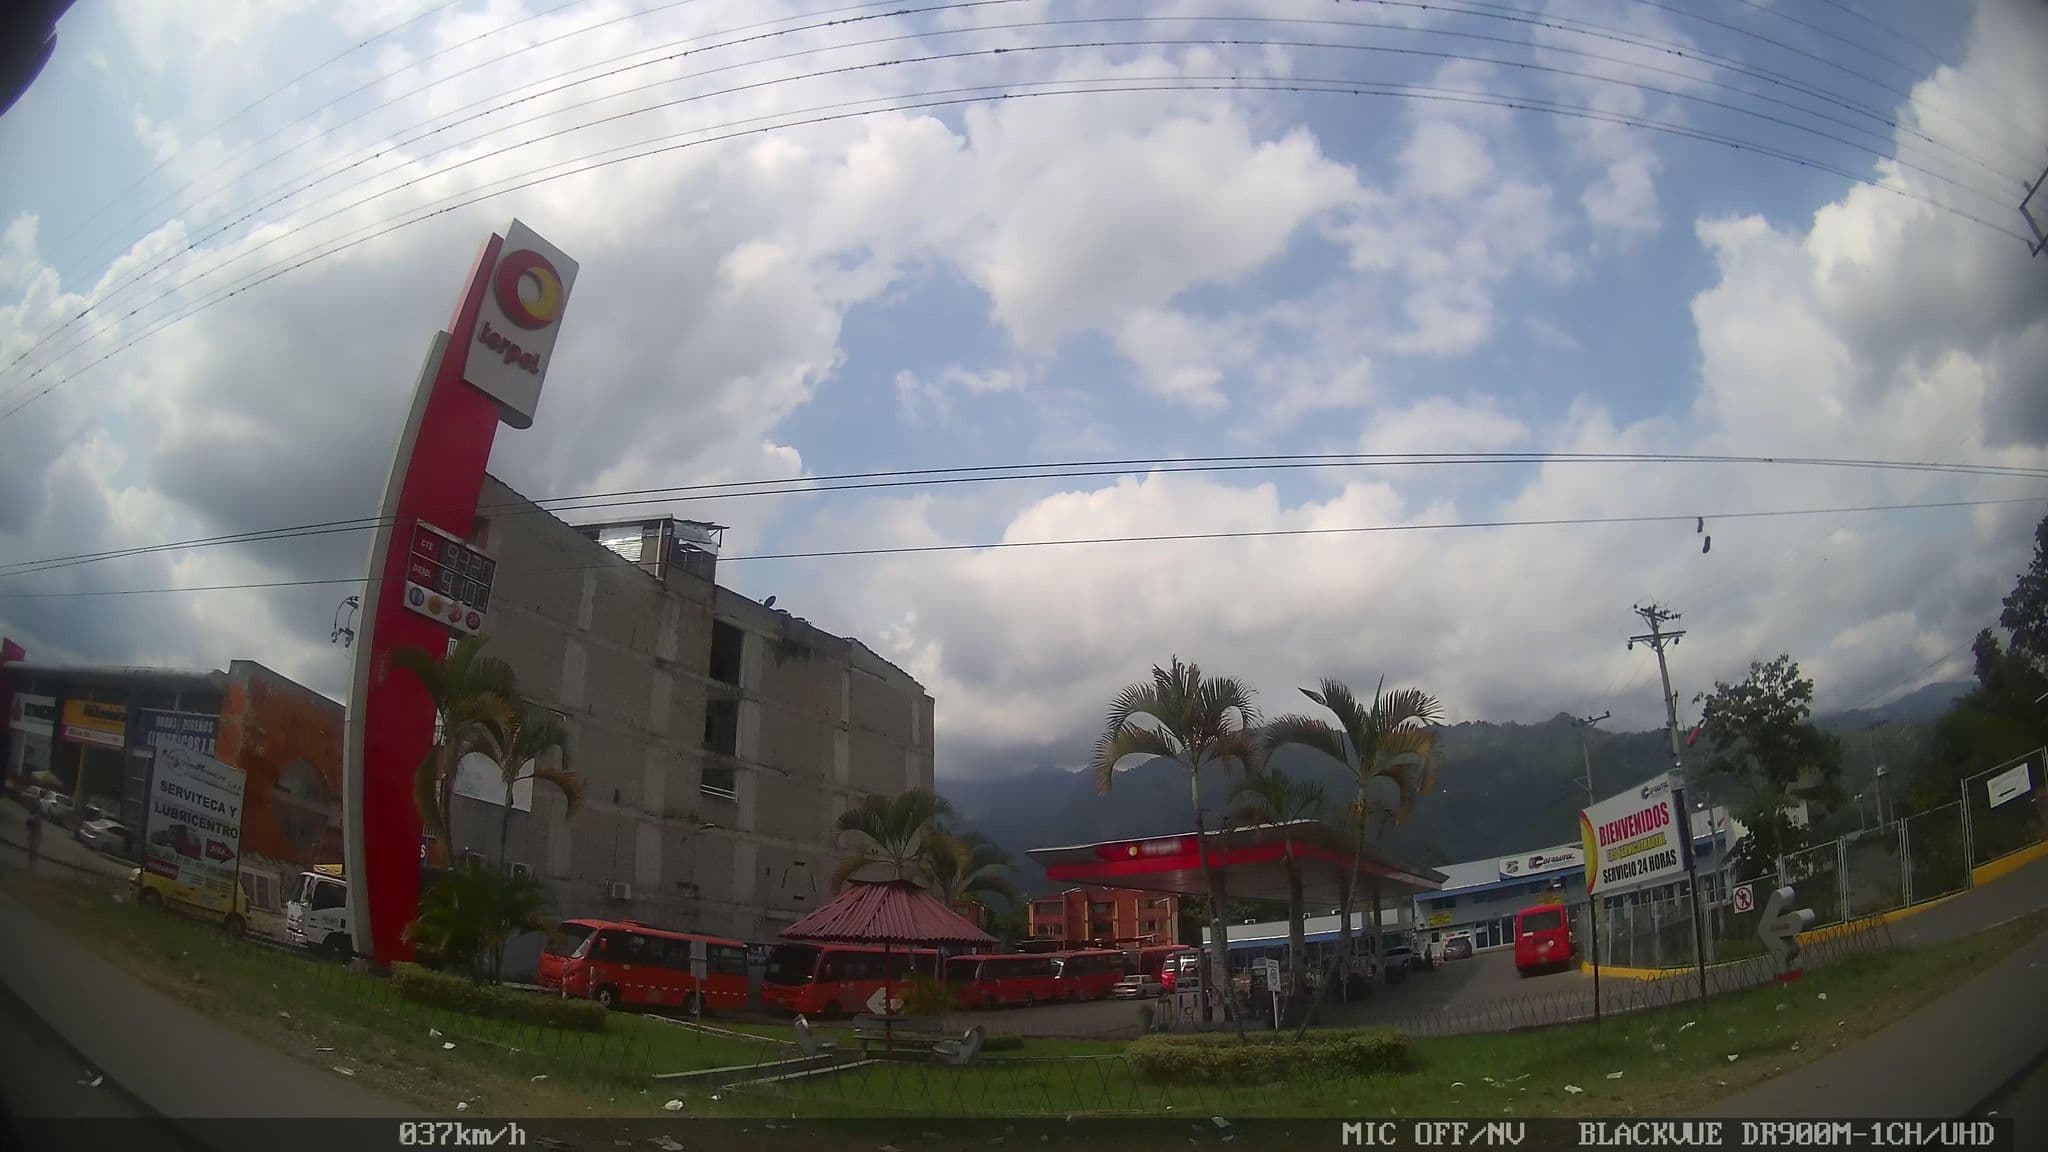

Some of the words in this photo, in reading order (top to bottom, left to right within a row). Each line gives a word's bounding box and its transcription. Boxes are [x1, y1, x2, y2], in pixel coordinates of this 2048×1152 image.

[478, 320, 541, 374] terpel
[160, 781, 225, 815] SERVITECA
[229, 805, 238, 818] Y
[154, 801, 238, 839] LUBRICENTRO
[1598, 801, 1670, 847] BIENVENIDOS
[1602, 860, 1637, 884] SERVICIO
[1636, 857, 1648, 875] 24
[1648, 848, 1677, 872] HORAS
